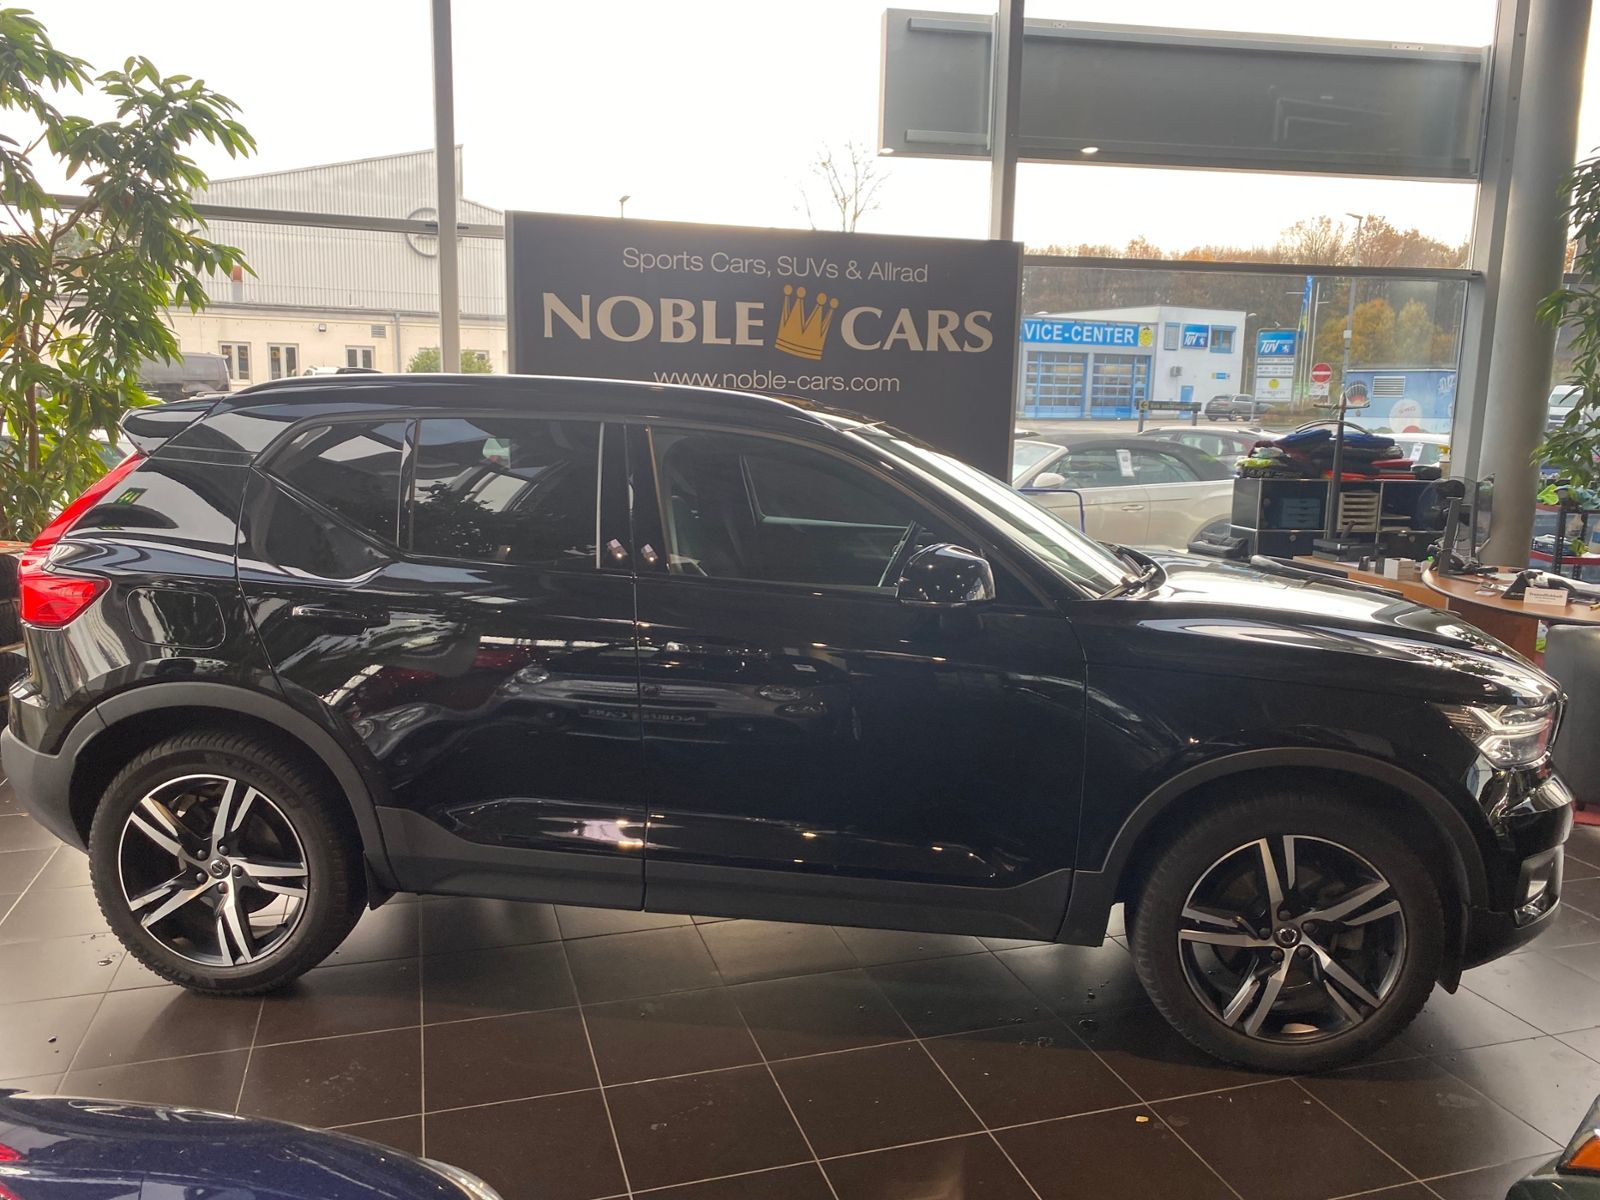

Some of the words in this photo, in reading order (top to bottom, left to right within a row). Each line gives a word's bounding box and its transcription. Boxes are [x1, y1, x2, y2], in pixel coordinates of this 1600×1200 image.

[622, 247, 704, 273] Sports
[710, 252, 771, 278] Cars,
[777, 255, 839, 279] SUVs
[845, 260, 863, 281] &
[867, 261, 929, 283] Allrad
[543, 292, 765, 347] NOBLE
[840, 306, 994, 353] CARS
[1019, 323, 1134, 344] VICE-CENTER
[653, 370, 901, 392] www.noble-cars.com
